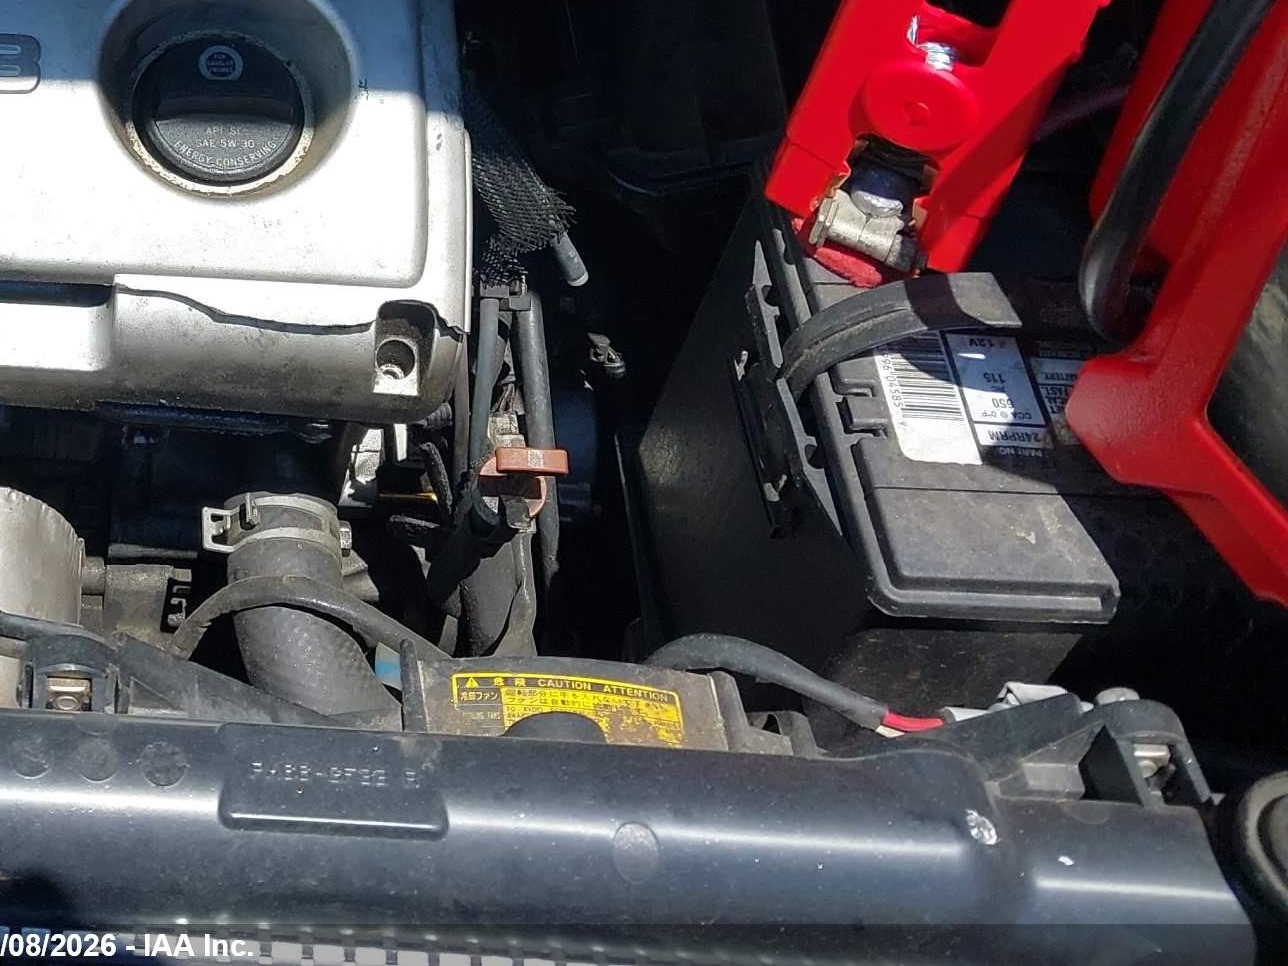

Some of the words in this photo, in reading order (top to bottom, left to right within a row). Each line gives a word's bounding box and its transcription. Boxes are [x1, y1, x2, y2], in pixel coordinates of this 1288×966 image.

[194, 139, 216, 148] SAE
[969, 338, 994, 347] 12V
[983, 372, 1006, 383] 115
[537, 679, 592, 691] CAUTION
[602, 684, 669, 702] ATTENTION
